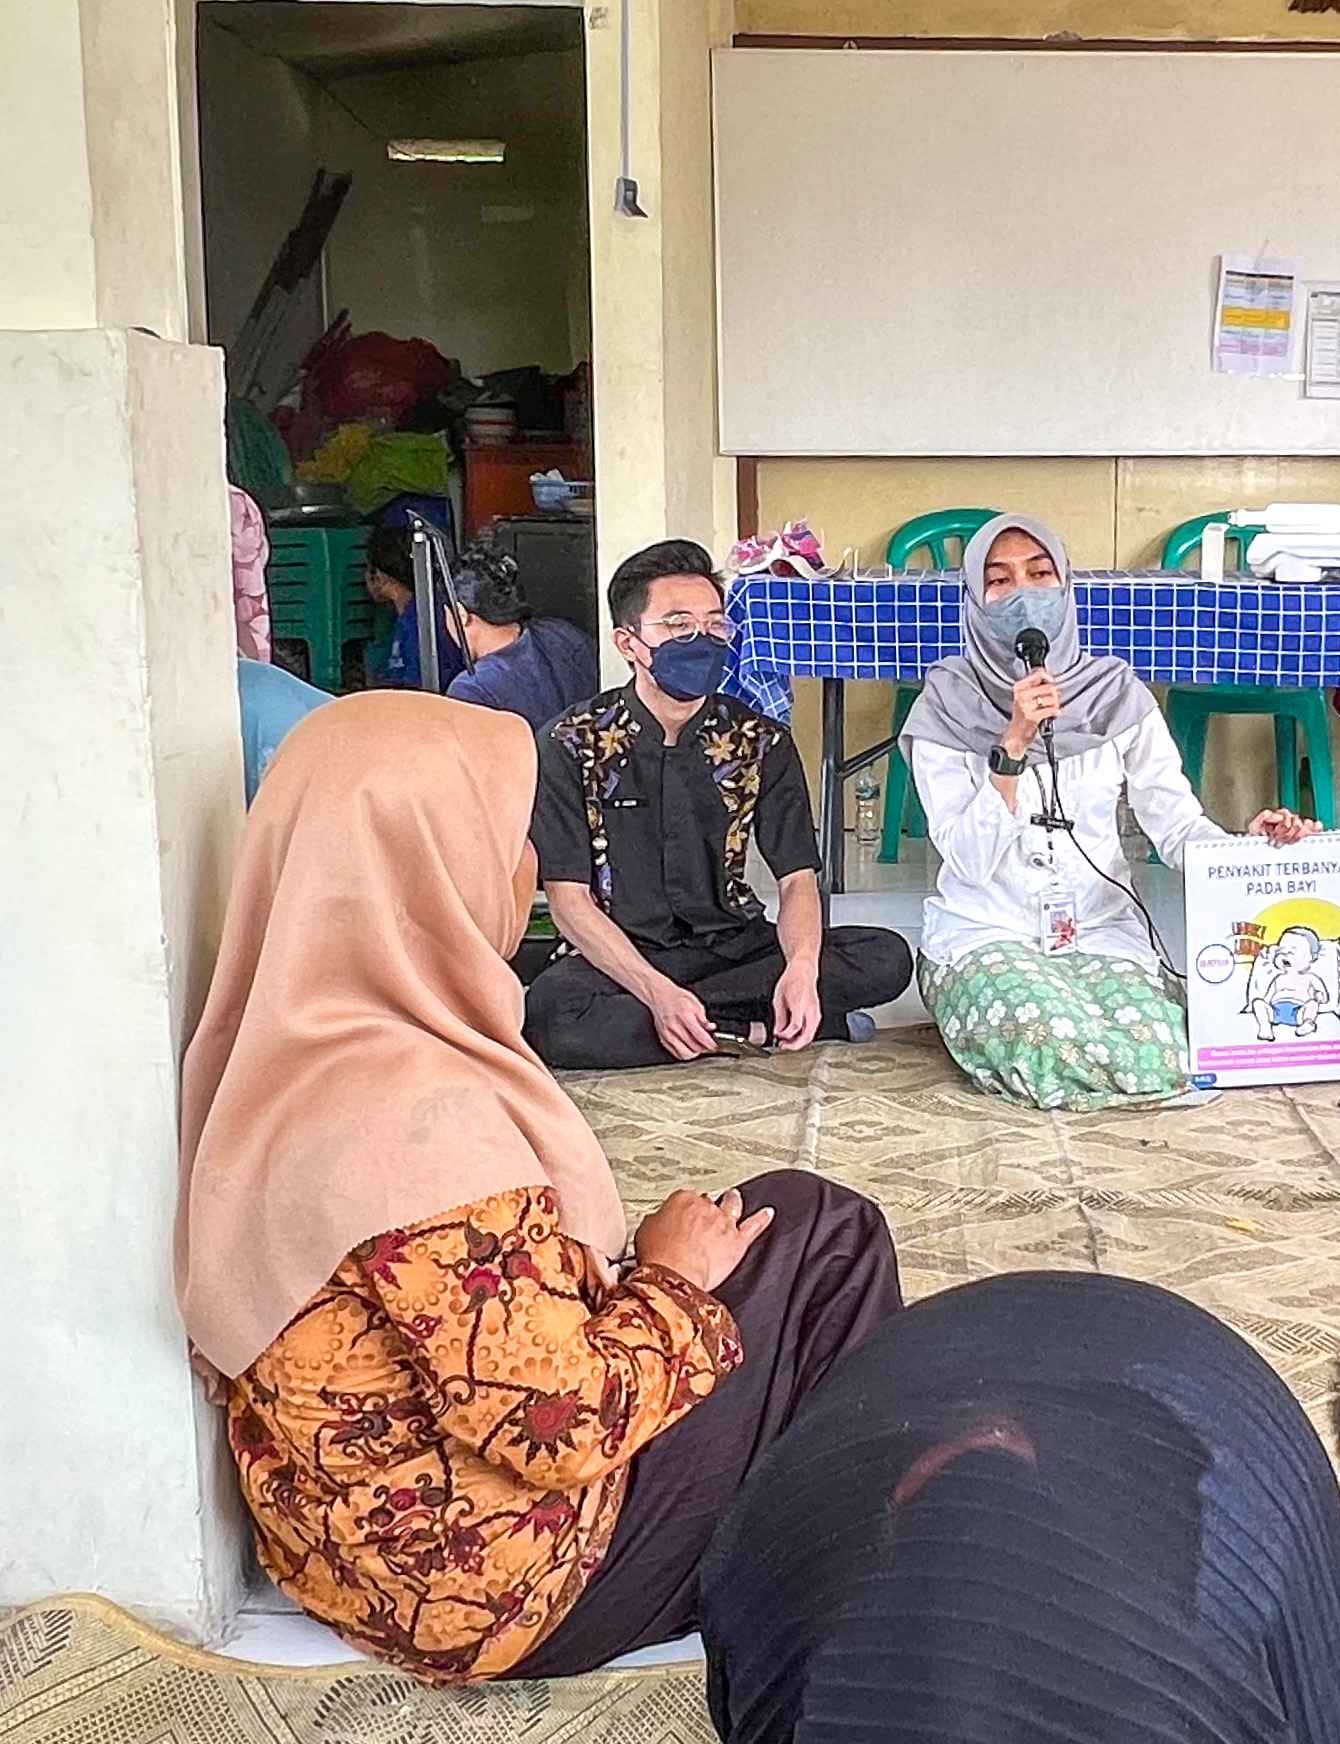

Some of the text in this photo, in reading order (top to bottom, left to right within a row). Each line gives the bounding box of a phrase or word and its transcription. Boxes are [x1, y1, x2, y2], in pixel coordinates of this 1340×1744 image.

[1207, 863, 1271, 879] PENYAKIT
[1246, 879, 1317, 896] PADA BAYI
